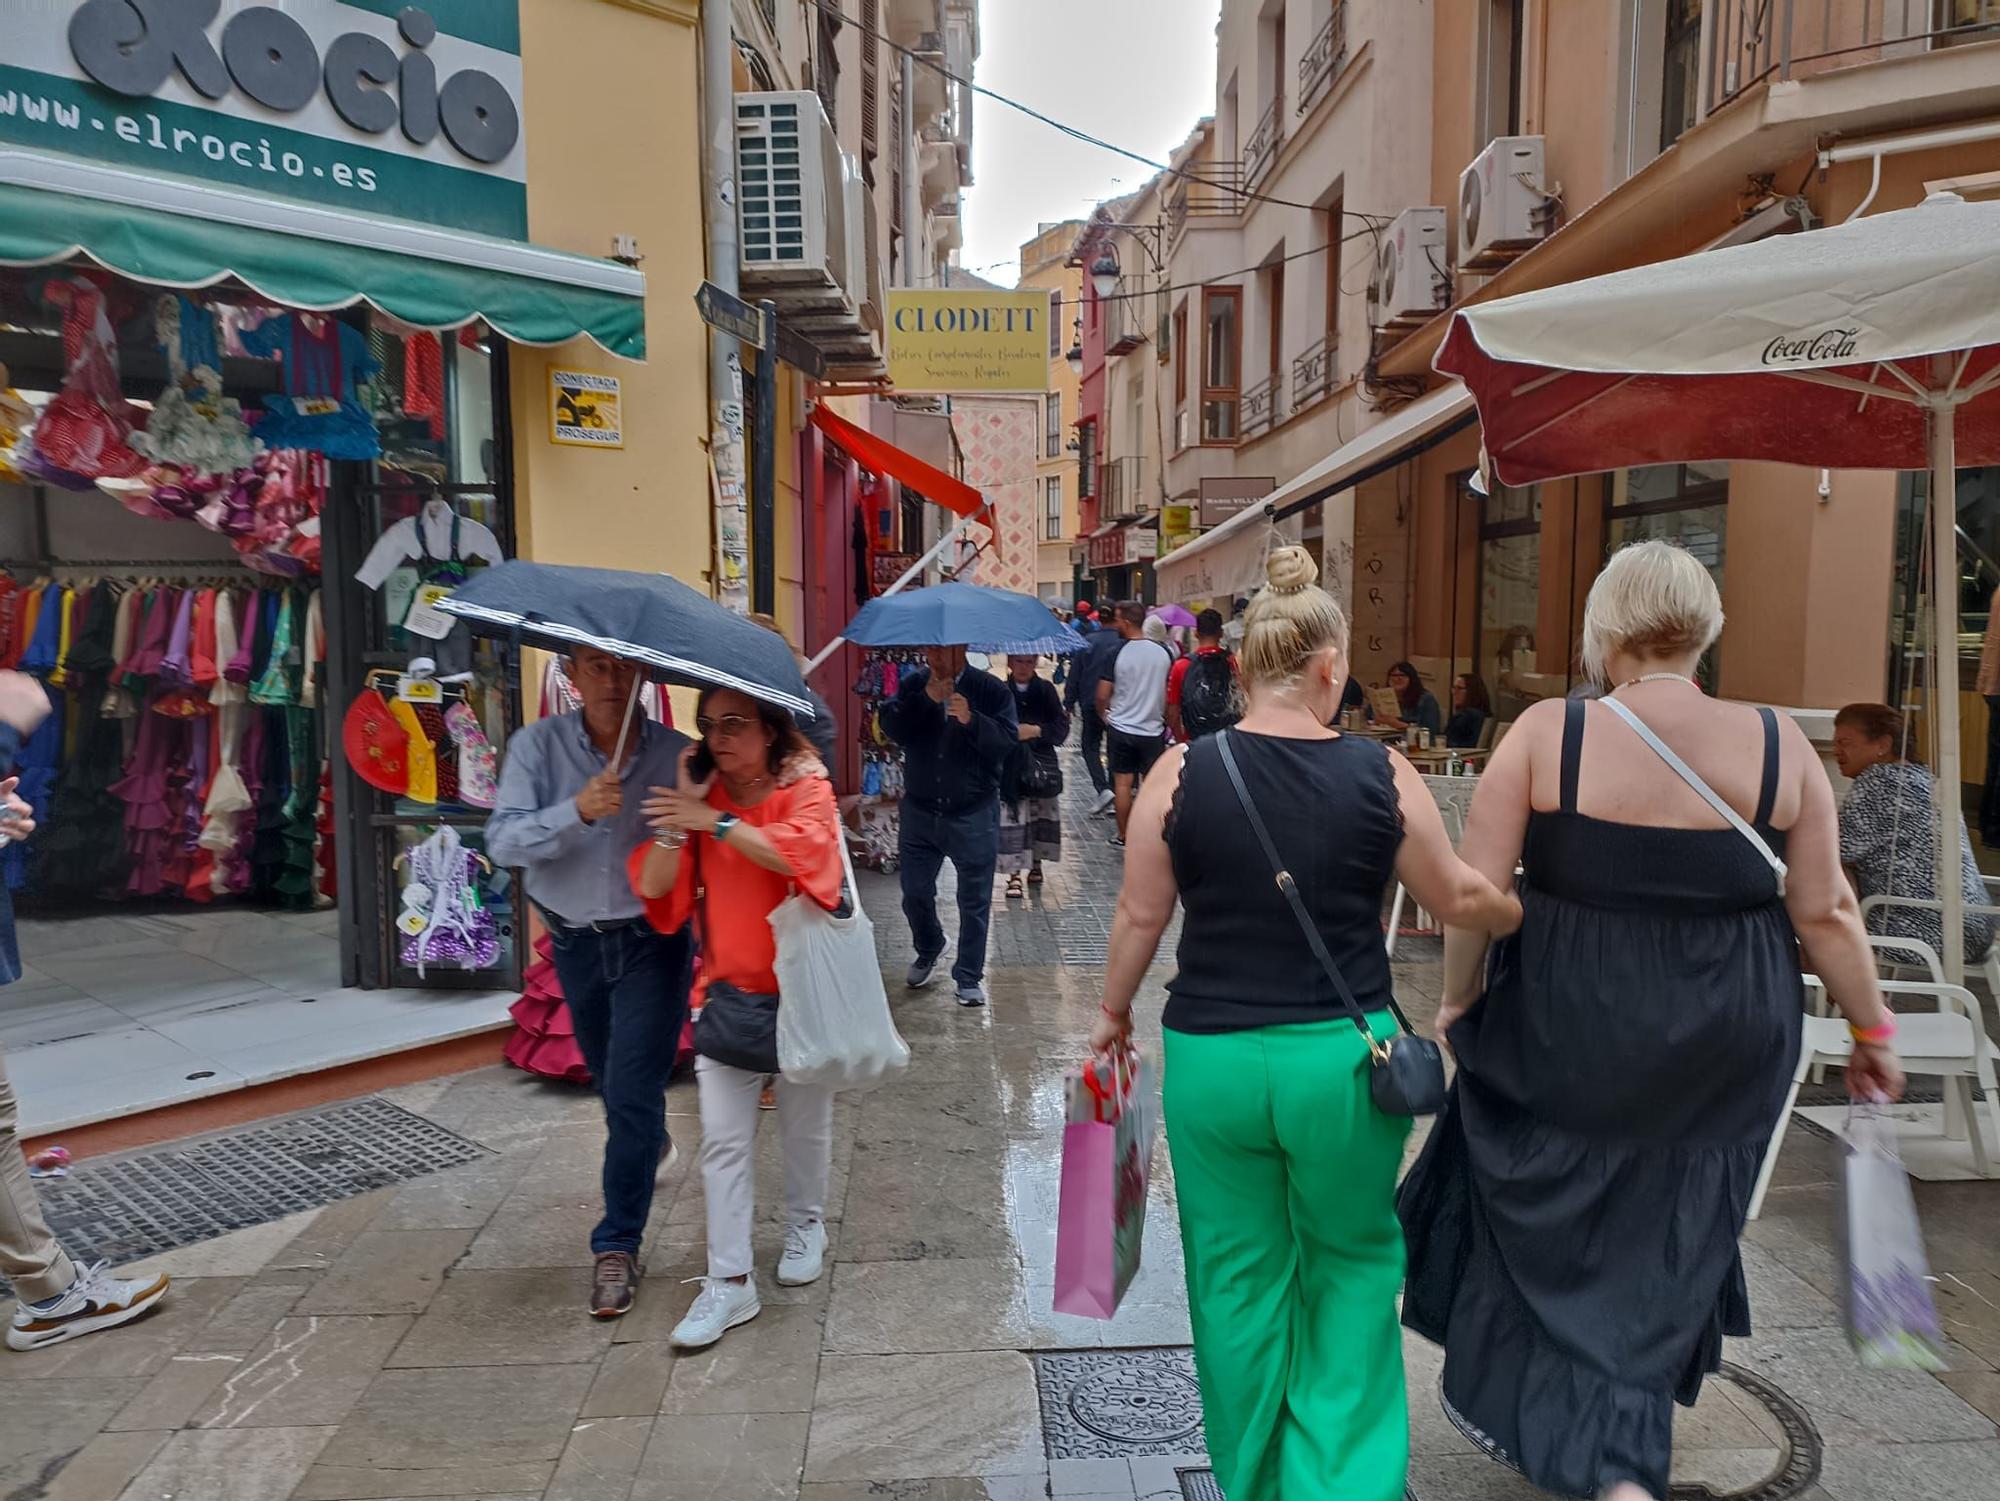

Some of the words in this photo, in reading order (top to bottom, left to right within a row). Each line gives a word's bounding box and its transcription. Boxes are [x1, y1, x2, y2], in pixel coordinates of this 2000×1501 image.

[894, 305, 1040, 333] CLODETT
[1761, 327, 1862, 365] Coca-Cola
[556, 426, 621, 441] PROSEGUR
